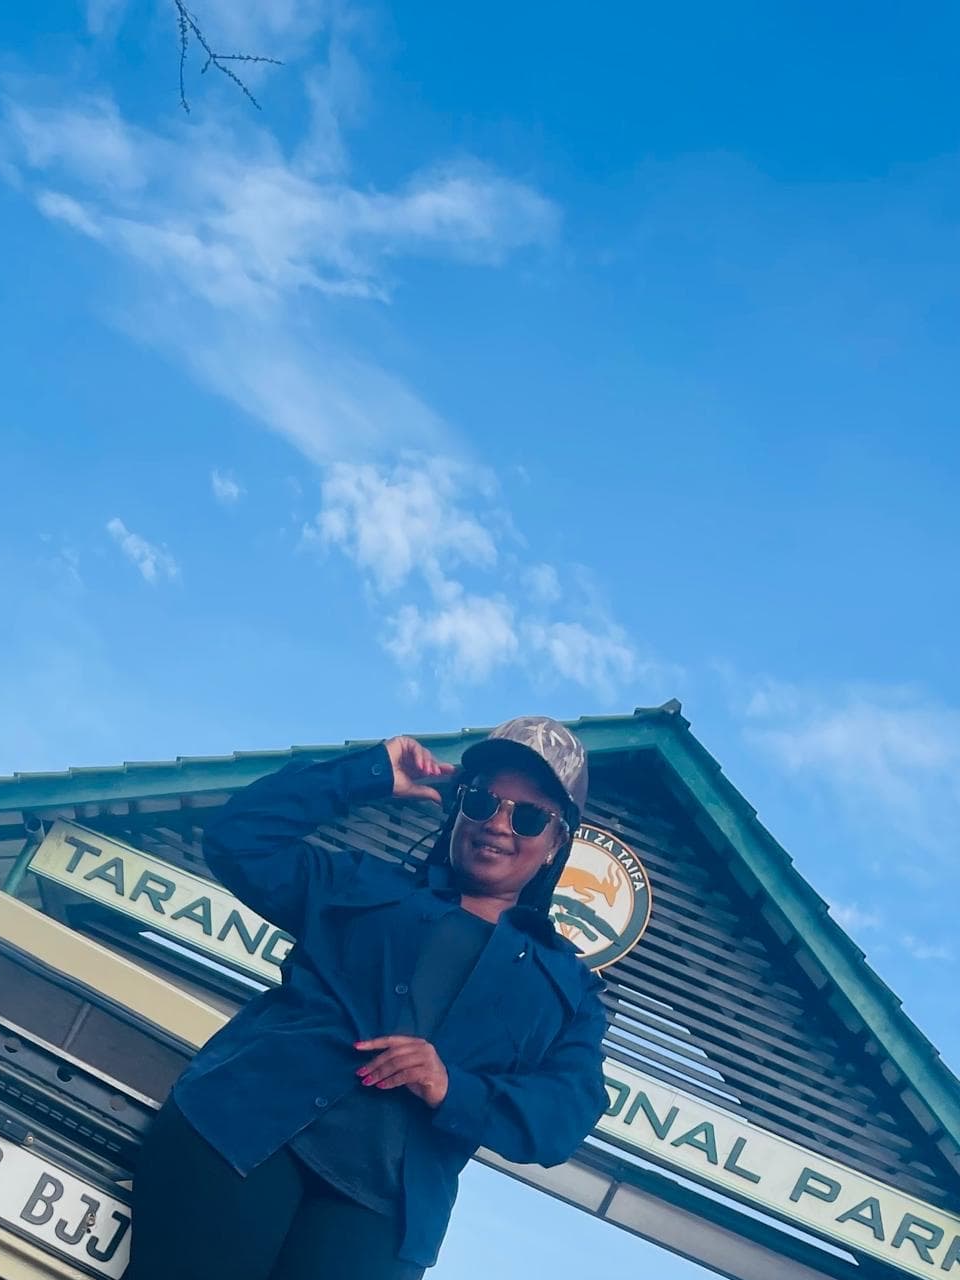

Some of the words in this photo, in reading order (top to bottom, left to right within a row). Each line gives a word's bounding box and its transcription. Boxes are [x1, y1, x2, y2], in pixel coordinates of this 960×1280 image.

[594, 833, 614, 852] ZA
[617, 848, 646, 892] TAIFA
[19, 1172, 132, 1263] BJJ
